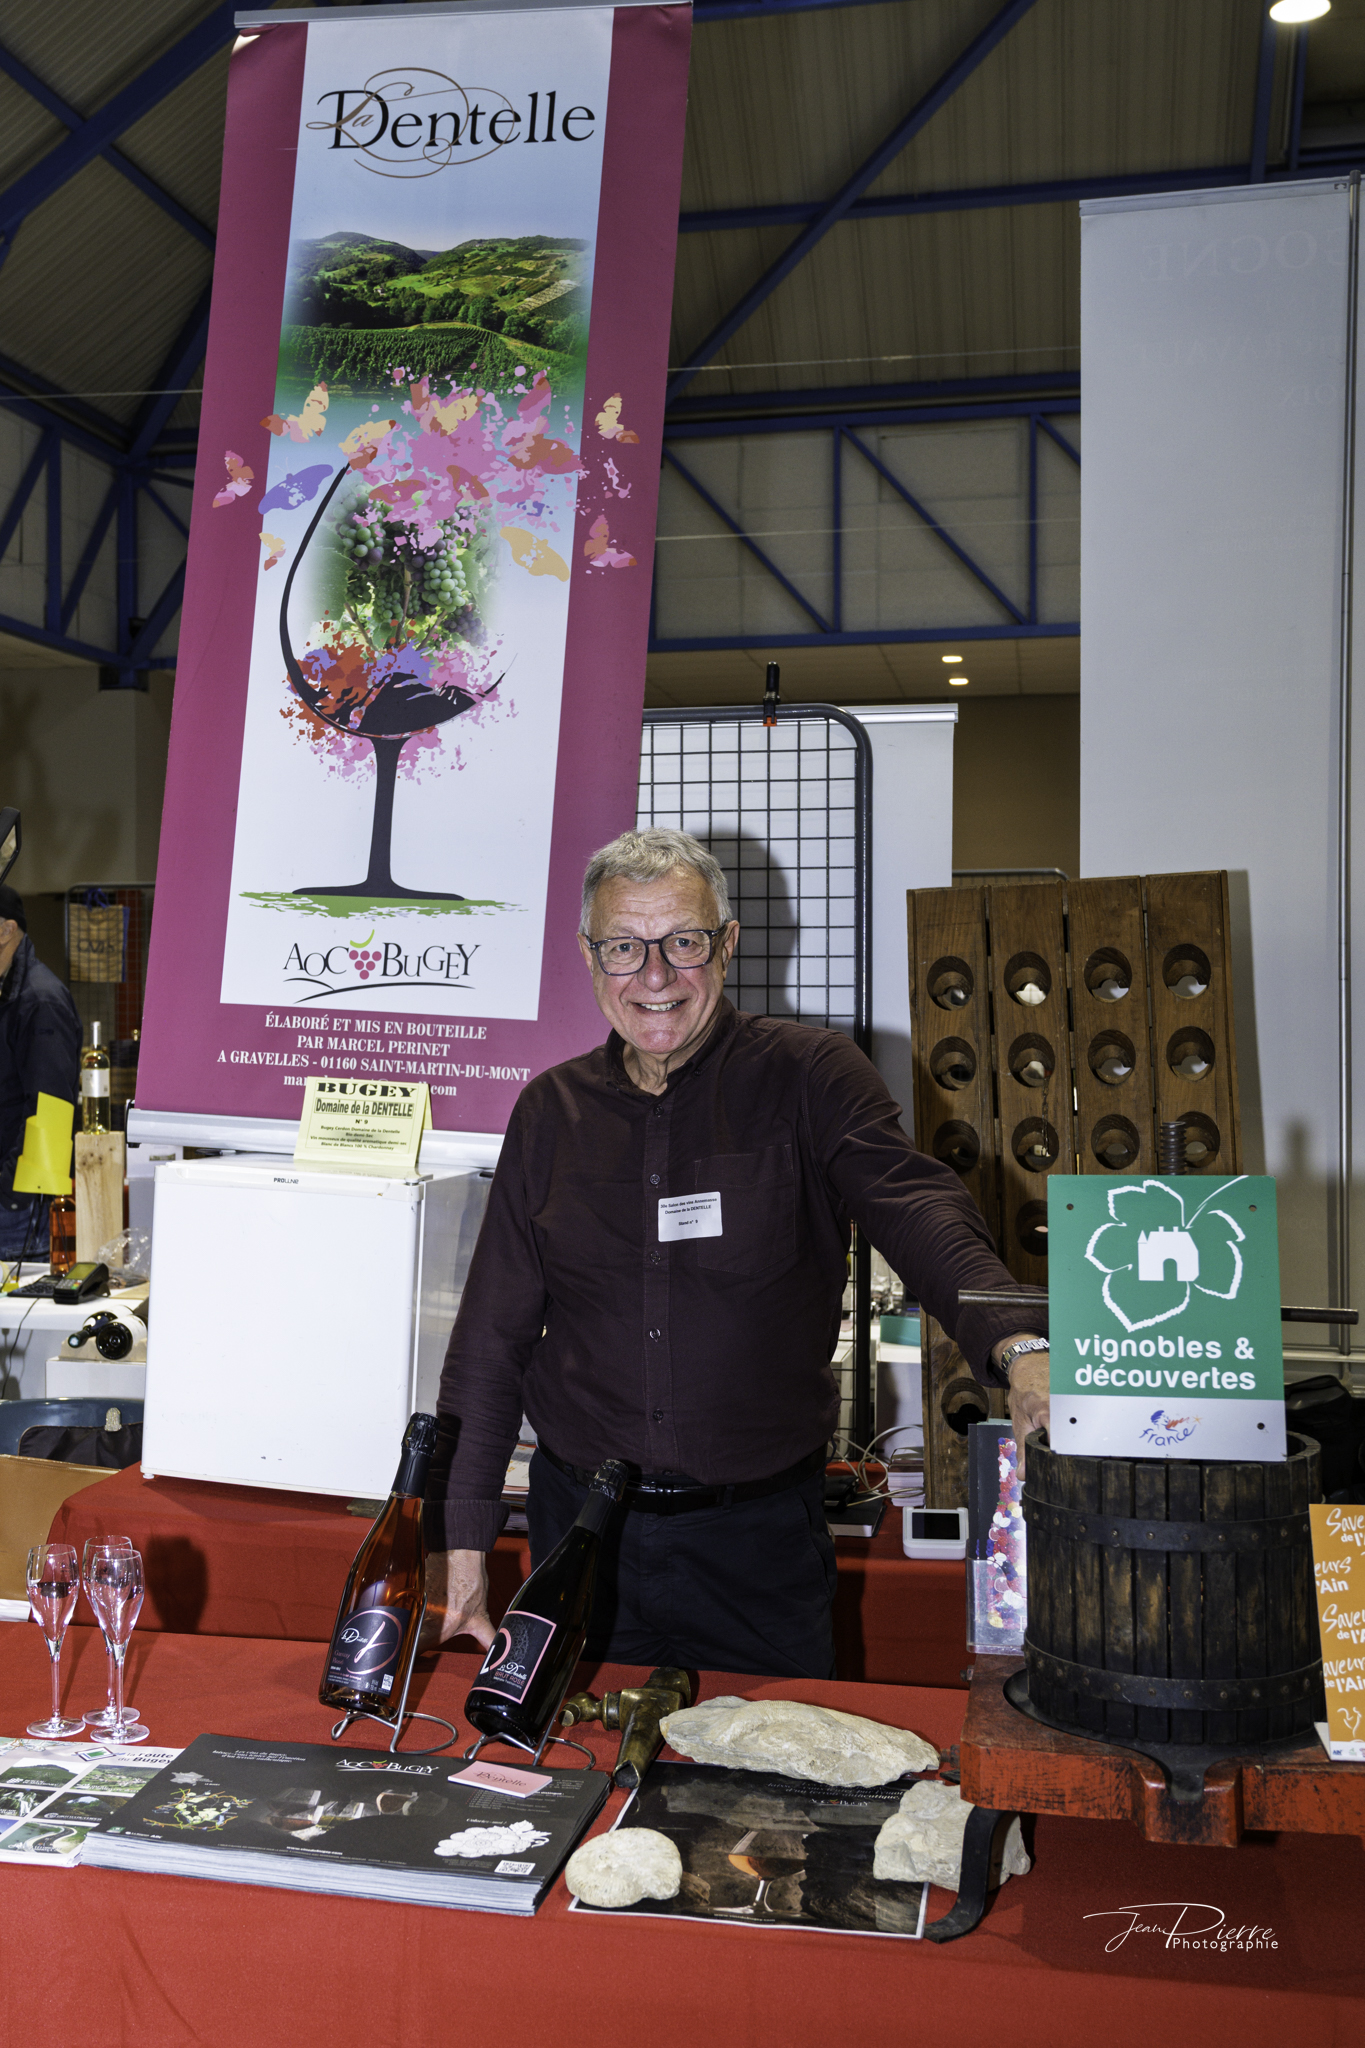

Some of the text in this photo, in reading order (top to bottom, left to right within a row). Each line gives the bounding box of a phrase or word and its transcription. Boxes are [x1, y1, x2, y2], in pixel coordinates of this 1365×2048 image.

[317, 90, 595, 149] Dentelle
[265, 1011, 487, 1040] ÉLABORÉ ET MIS EN BOUTEILLE
[297, 1035, 450, 1057] PAR MARCEL PERINET
[217, 1050, 227, 1063] A
[230, 1050, 309, 1067] GRAVELLES
[320, 1056, 357, 1070] 01160
[360, 1058, 530, 1081] SAINT-MARTIN-DU-MONT
[317, 1082, 417, 1098] BUGEY
[315, 1098, 413, 1117] Domaine de la DENTELLE
[1074, 1334, 1256, 1363] vignobles &
[1075, 1364, 1256, 1390] découvertes
[1341, 1533, 1354, 1543] de
[1336, 1629, 1350, 1640] de
[494, 1671, 509, 1680] BRUT
